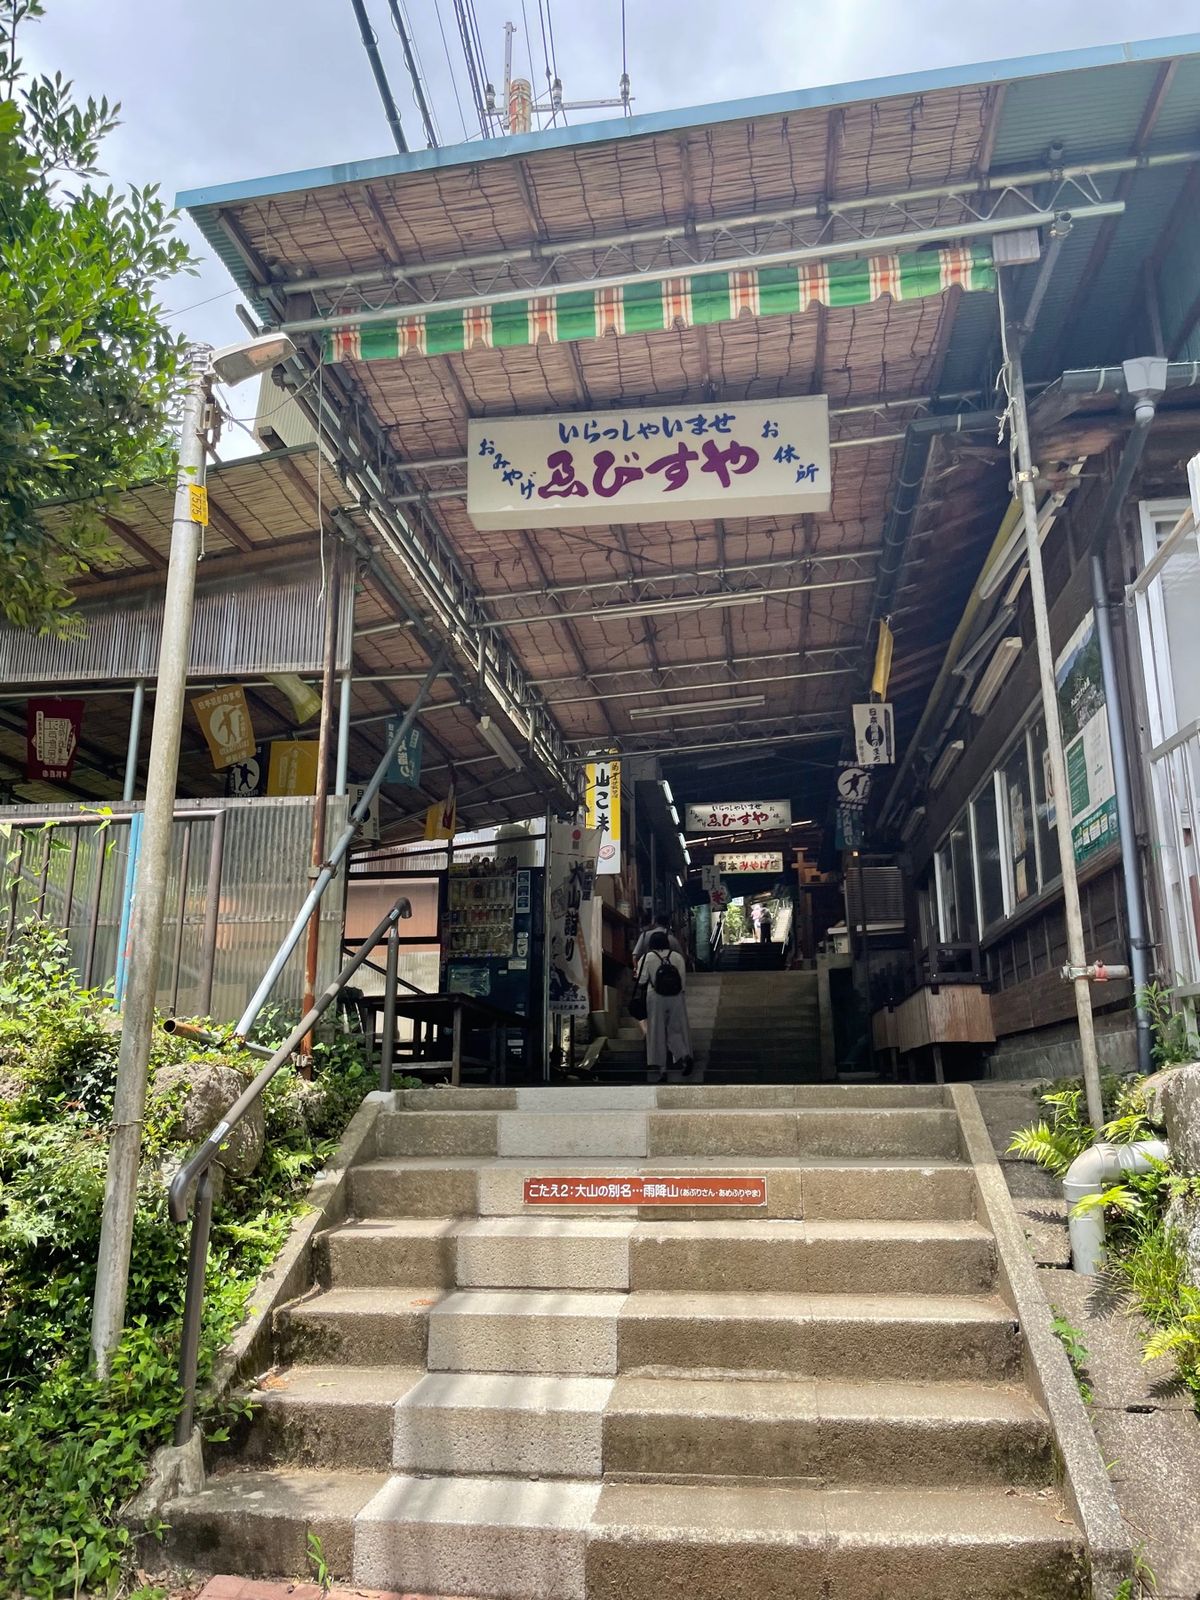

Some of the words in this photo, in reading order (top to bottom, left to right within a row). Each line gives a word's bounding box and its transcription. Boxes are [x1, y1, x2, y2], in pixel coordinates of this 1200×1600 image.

[558, 413, 736, 444] いらっしゃいませ
[478, 437, 536, 500] おみやげ
[537, 439, 760, 499] ゑびすや
[706, 812, 769, 827] ゑびすや
